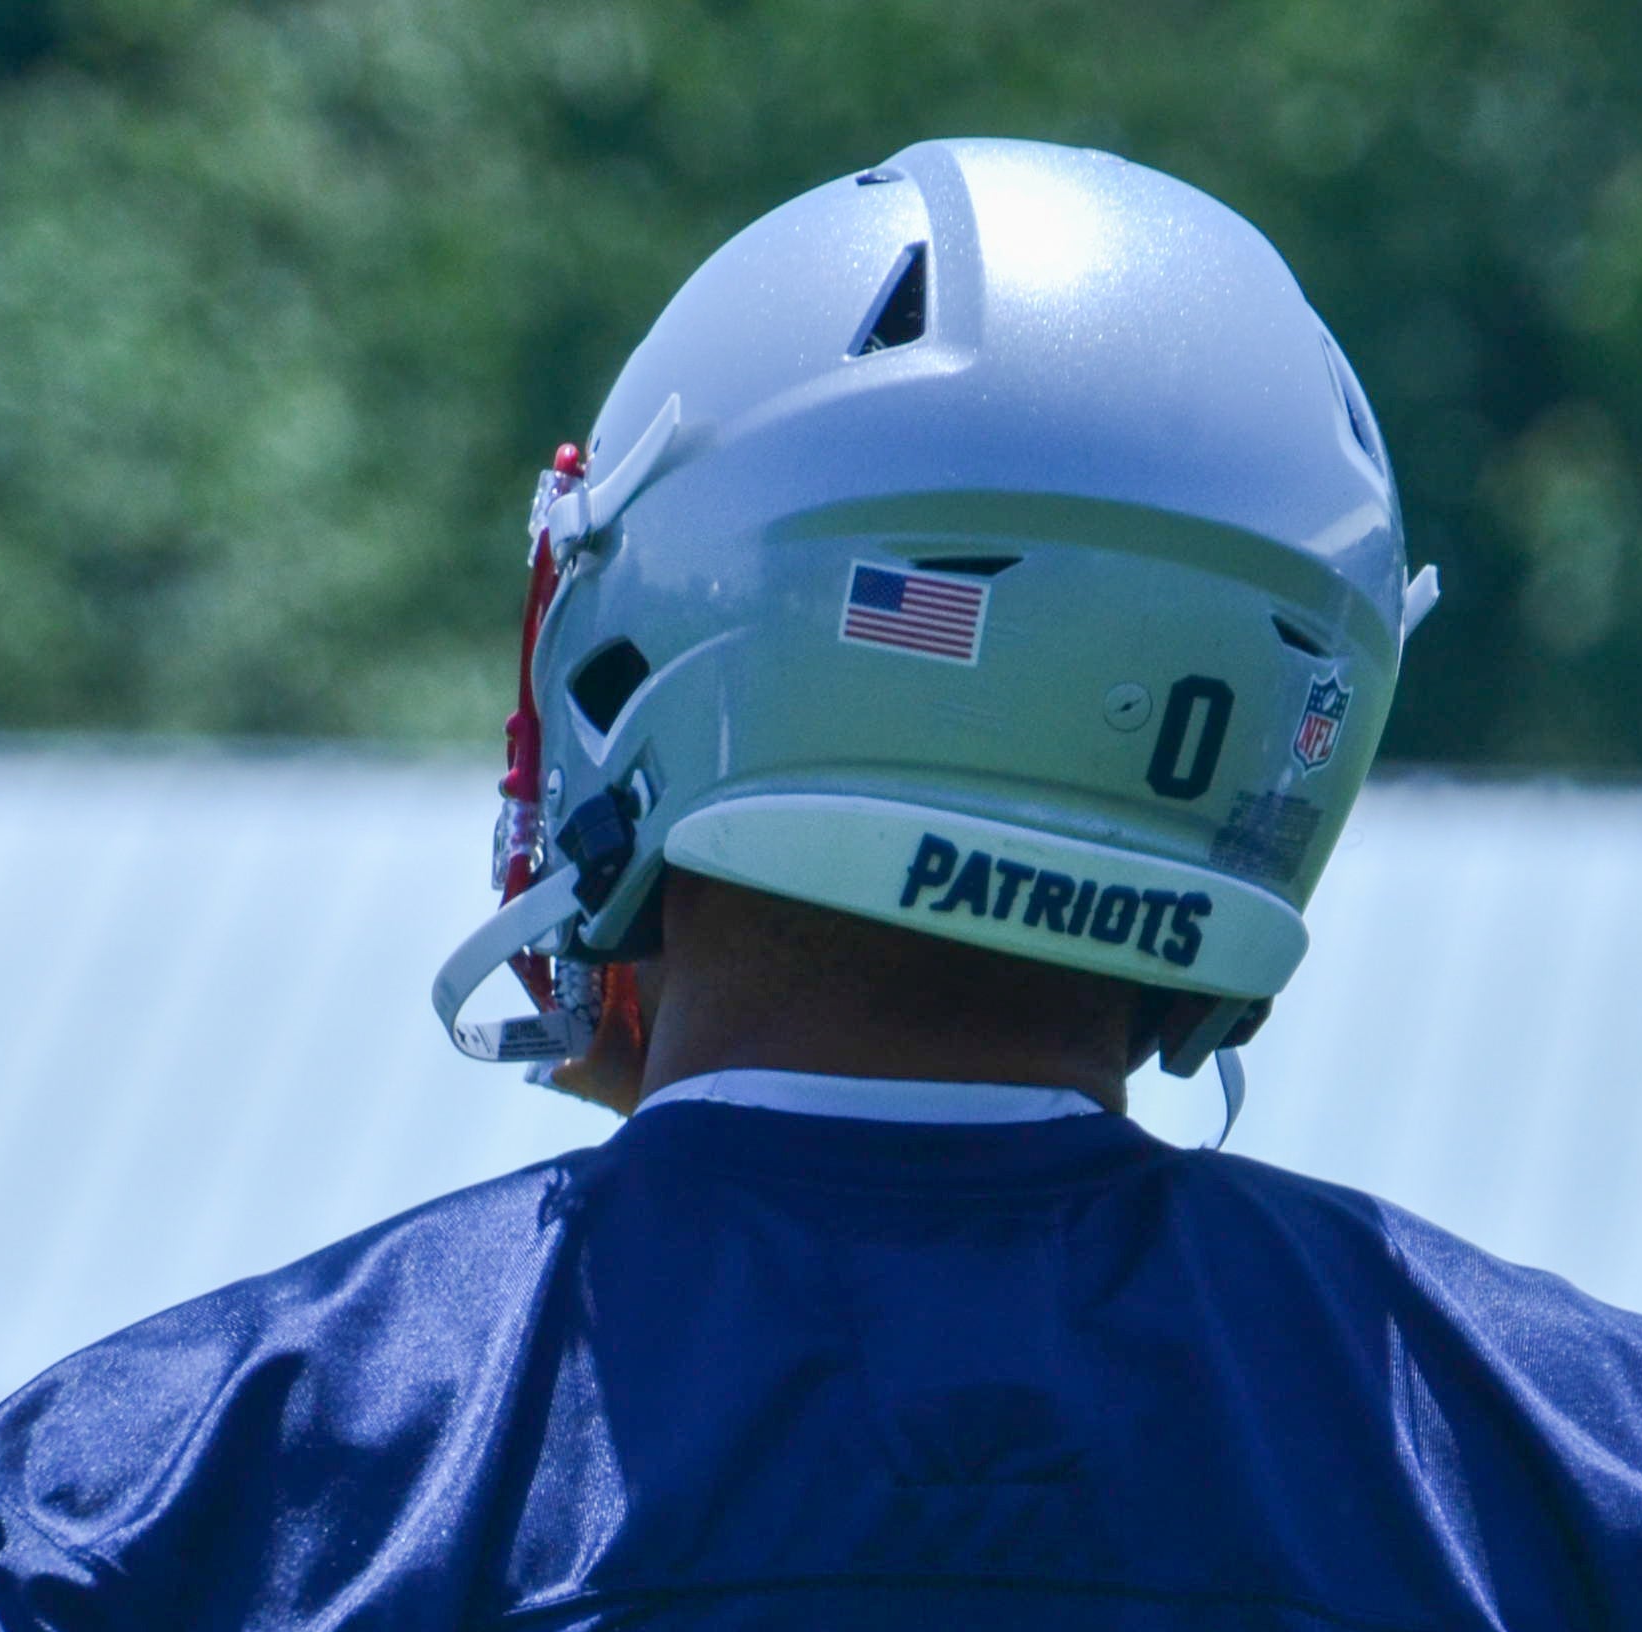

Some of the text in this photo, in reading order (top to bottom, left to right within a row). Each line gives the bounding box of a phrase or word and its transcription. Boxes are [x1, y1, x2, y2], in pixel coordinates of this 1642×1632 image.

[1145, 675, 1235, 800] 0
[1295, 712, 1340, 764] NFL
[899, 832, 1213, 968] PATRIOTS
